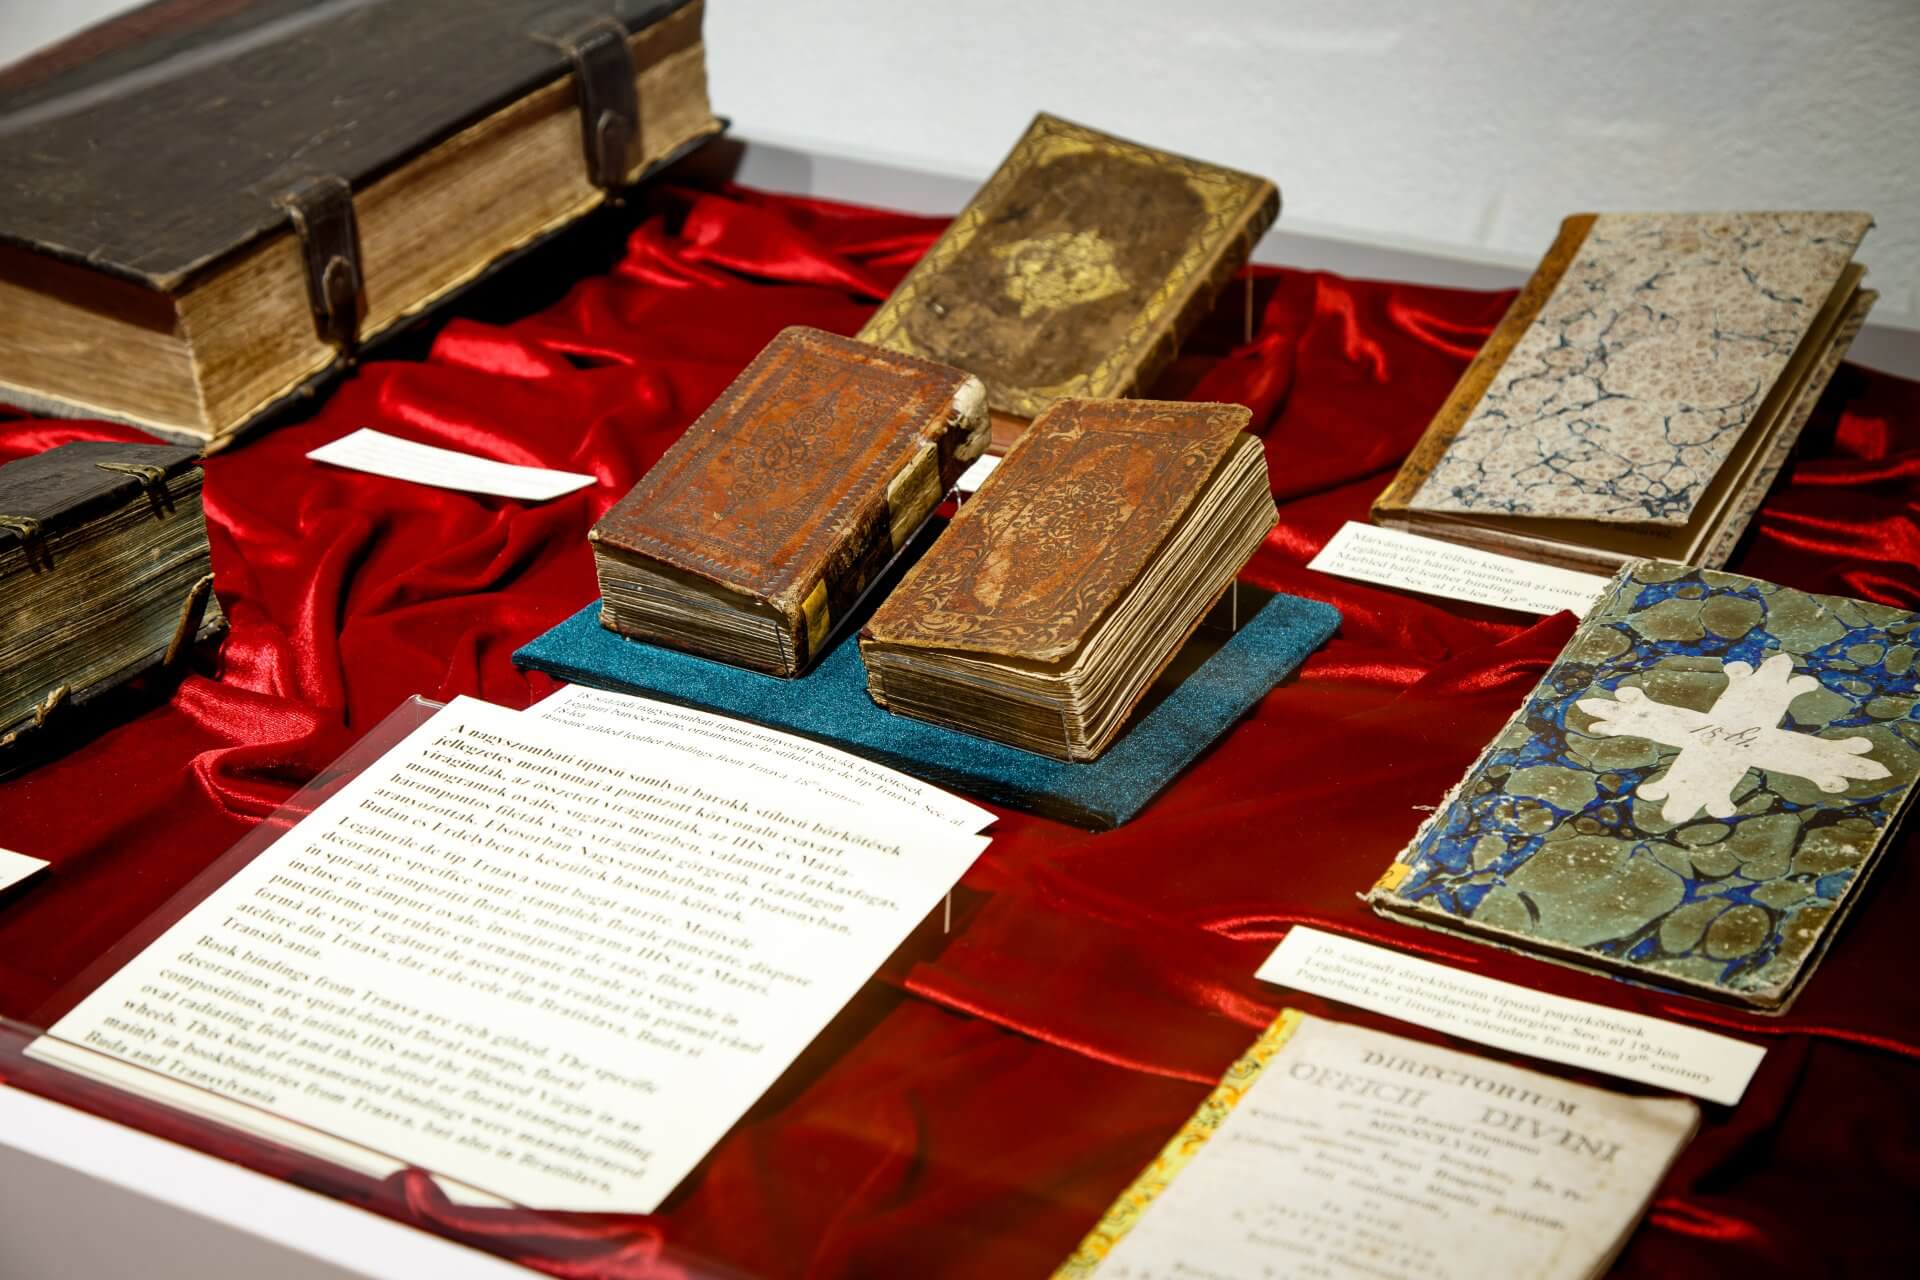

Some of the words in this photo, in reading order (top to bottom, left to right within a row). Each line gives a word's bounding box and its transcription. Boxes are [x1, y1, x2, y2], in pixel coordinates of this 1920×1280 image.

[1335, 551, 1389, 569] Marbled
[1388, 562, 1463, 584] half-leather
[453, 724, 465, 734] A
[467, 729, 573, 764] nagyszombati
[433, 735, 512, 764] jellegzetes
[613, 788, 693, 813] pontozott
[511, 777, 530, 785] az
[405, 762, 507, 798] monogramok
[567, 809, 623, 830] sugaras
[321, 831, 402, 863] decorative
[373, 788, 475, 824] aranyozottak.
[581, 845, 717, 896] Nagyszombatban,
[551, 822, 583, 838] vagy
[287, 860, 343, 883] incluse
[517, 850, 530, 859] is
[267, 874, 369, 912] punctiforme
[236, 904, 297, 928] ateliere
[298, 923, 326, 939] din
[305, 906, 327, 919] de
[222, 916, 321, 958] Transilvania.
[1295, 967, 1380, 998] Paperbacks
[1383, 994, 1404, 1005] of
[1362, 1050, 1579, 1118] DIRECTORIUM
[1287, 1057, 1430, 1109] OFFICII
[1479, 1106, 1625, 1165] DIVINI
